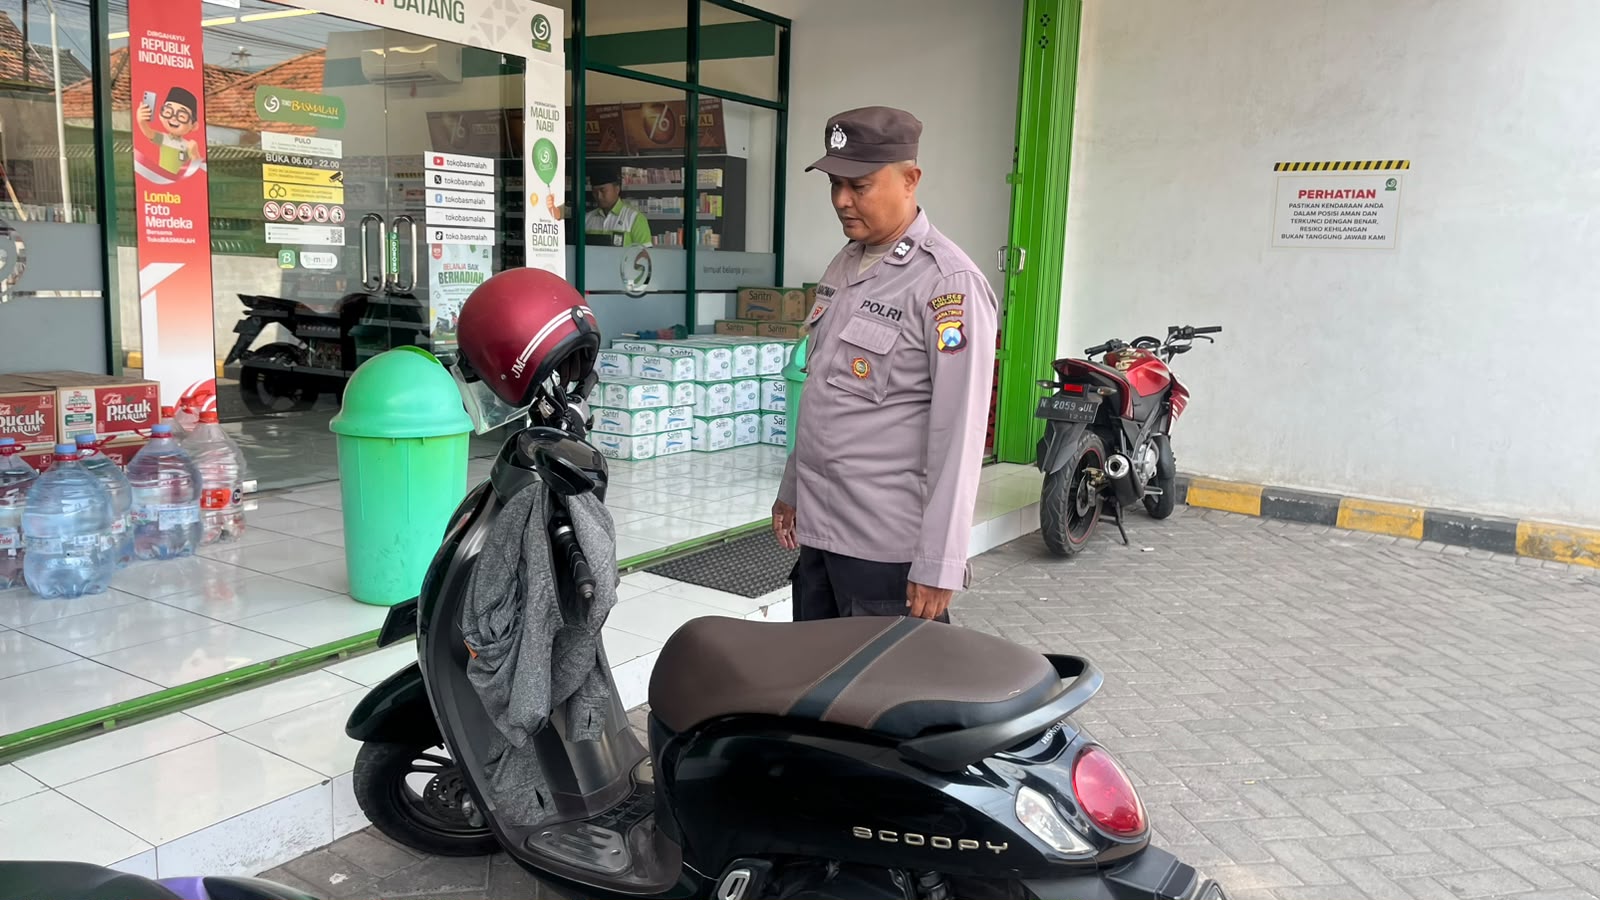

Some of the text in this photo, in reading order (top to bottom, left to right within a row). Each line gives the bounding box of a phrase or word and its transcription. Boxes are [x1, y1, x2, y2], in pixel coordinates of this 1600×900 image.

[147, 30, 186, 42] DIRGAHAYU
[141, 37, 191, 56] REPUBLIK
[138, 50, 194, 70] INDONESIA
[291, 100, 339, 115] BASMALAH
[530, 106, 560, 121] MAULID
[536, 120, 554, 132] NABI
[294, 137, 311, 145] PULO
[265, 153, 290, 163] BUKA
[291, 157, 313, 166] 06.00
[446, 159, 487, 169] tokobasmalah
[444, 178, 485, 187] tokobasmalah
[144, 191, 181, 204] Lomba
[1298, 189, 1376, 199] PERHATIAN
[445, 196, 486, 205] tokobasmalah
[144, 203, 170, 216] Foto
[145, 216, 193, 229] Merdeka
[445, 214, 486, 222] tokobasmalah
[532, 223, 559, 235] GRATIS
[446, 233, 488, 241] toko.basmalah
[532, 235, 559, 247] BALON
[438, 271, 484, 284] BERHADIAH
[749, 290, 772, 301] Santri
[932, 294, 962, 306] POLRES
[860, 300, 903, 322] POLRI
[768, 325, 787, 333] Santri
[624, 344, 647, 352] Santri
[670, 348, 694, 356] Santri
[601, 353, 618, 361] Santri
[643, 356, 661, 364] Santri
[511, 357, 526, 379] JM
[102, 393, 122, 405] Teh
[1040, 398, 1094, 413] N 2059 UL
[114, 412, 148, 422] HARUM
[602, 410, 619, 418] Santri
[3, 424, 41, 434] HARUM
[852, 826, 1008, 854] SCOOPY
